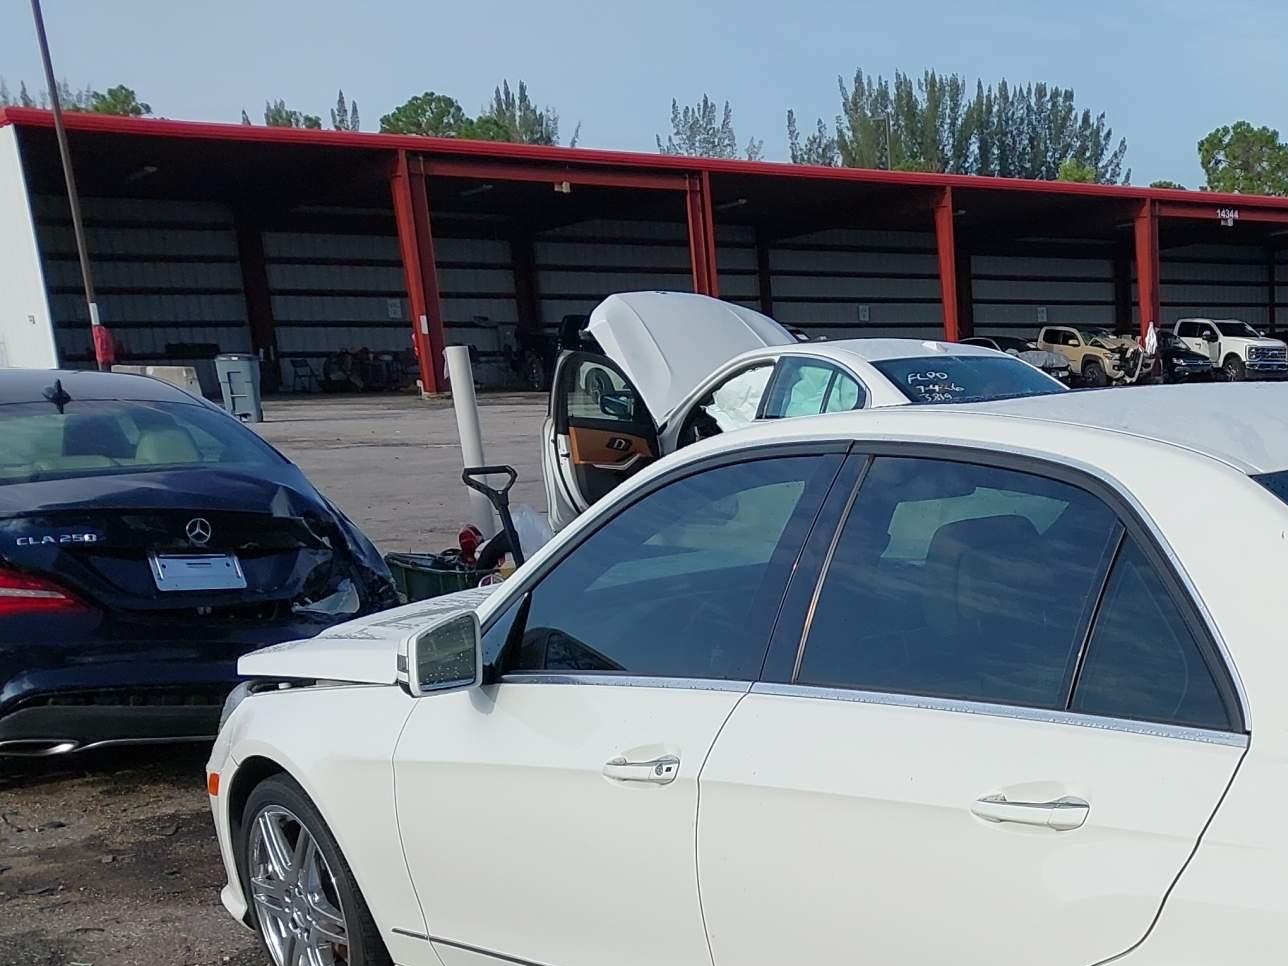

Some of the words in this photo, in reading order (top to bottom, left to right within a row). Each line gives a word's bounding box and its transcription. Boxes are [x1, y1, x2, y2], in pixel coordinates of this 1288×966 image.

[1216, 208, 1239, 219] 14344
[16, 535, 56, 546] CLA
[60, 533, 97, 543] 250
